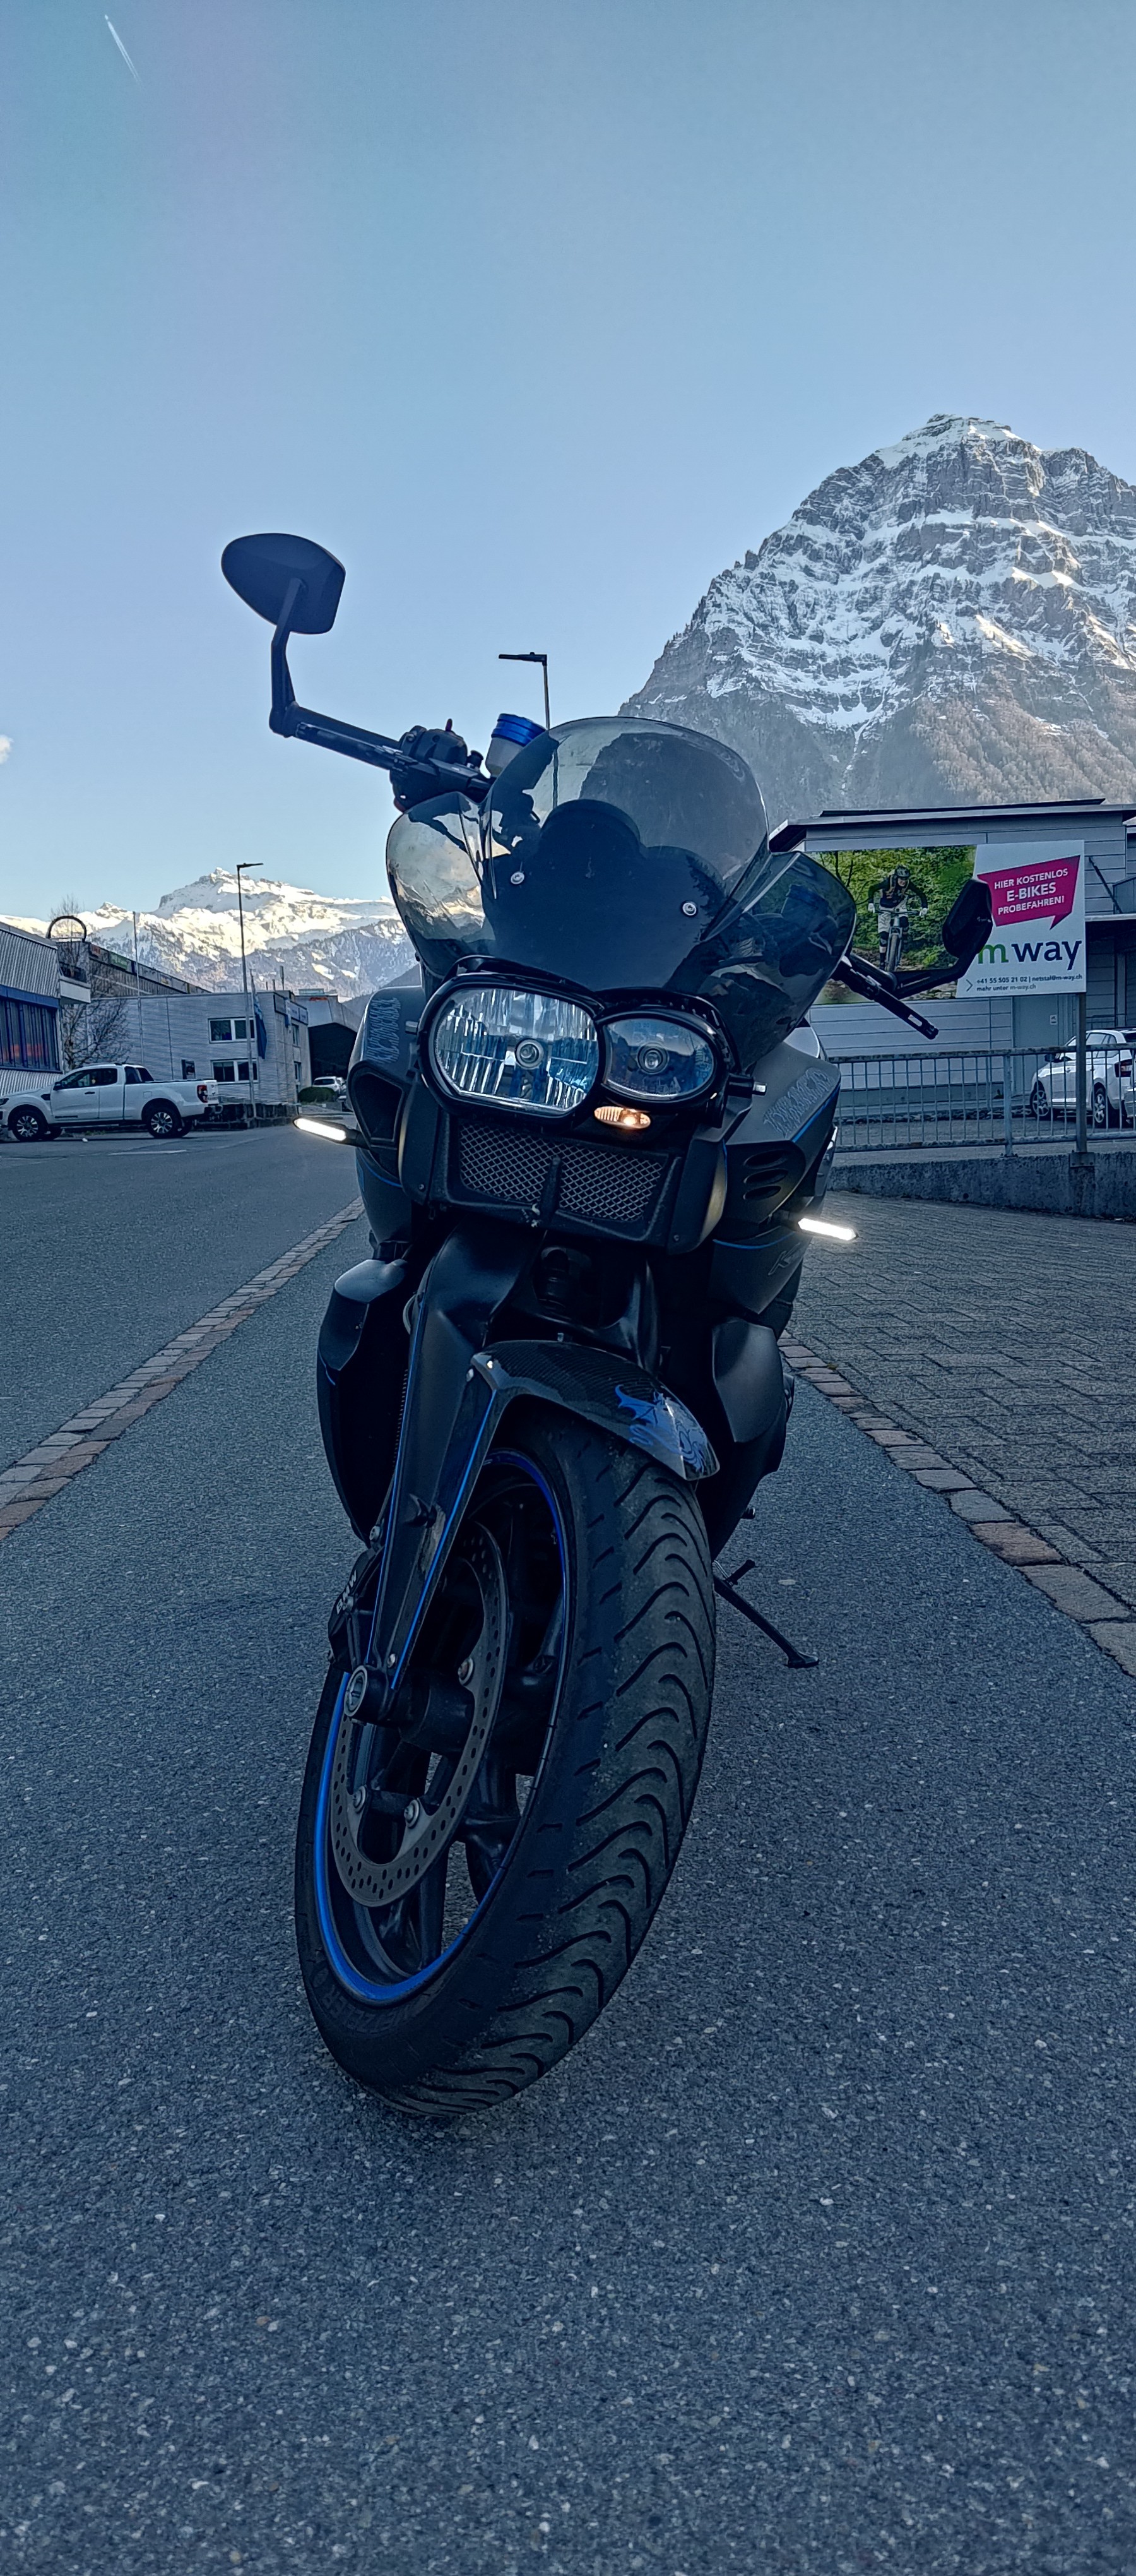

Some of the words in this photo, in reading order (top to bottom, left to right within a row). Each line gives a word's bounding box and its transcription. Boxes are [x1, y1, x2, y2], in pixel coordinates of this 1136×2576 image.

[994, 879, 1014, 890] HIER
[1016, 868, 1068, 885] KOSTENLOS
[1007, 882, 1056, 902] E-BIKES
[998, 895, 1065, 915] PROBEFAHREN!
[978, 944, 1009, 964] m
[1011, 940, 1082, 970] way
[336, 1569, 357, 1614] BMW
